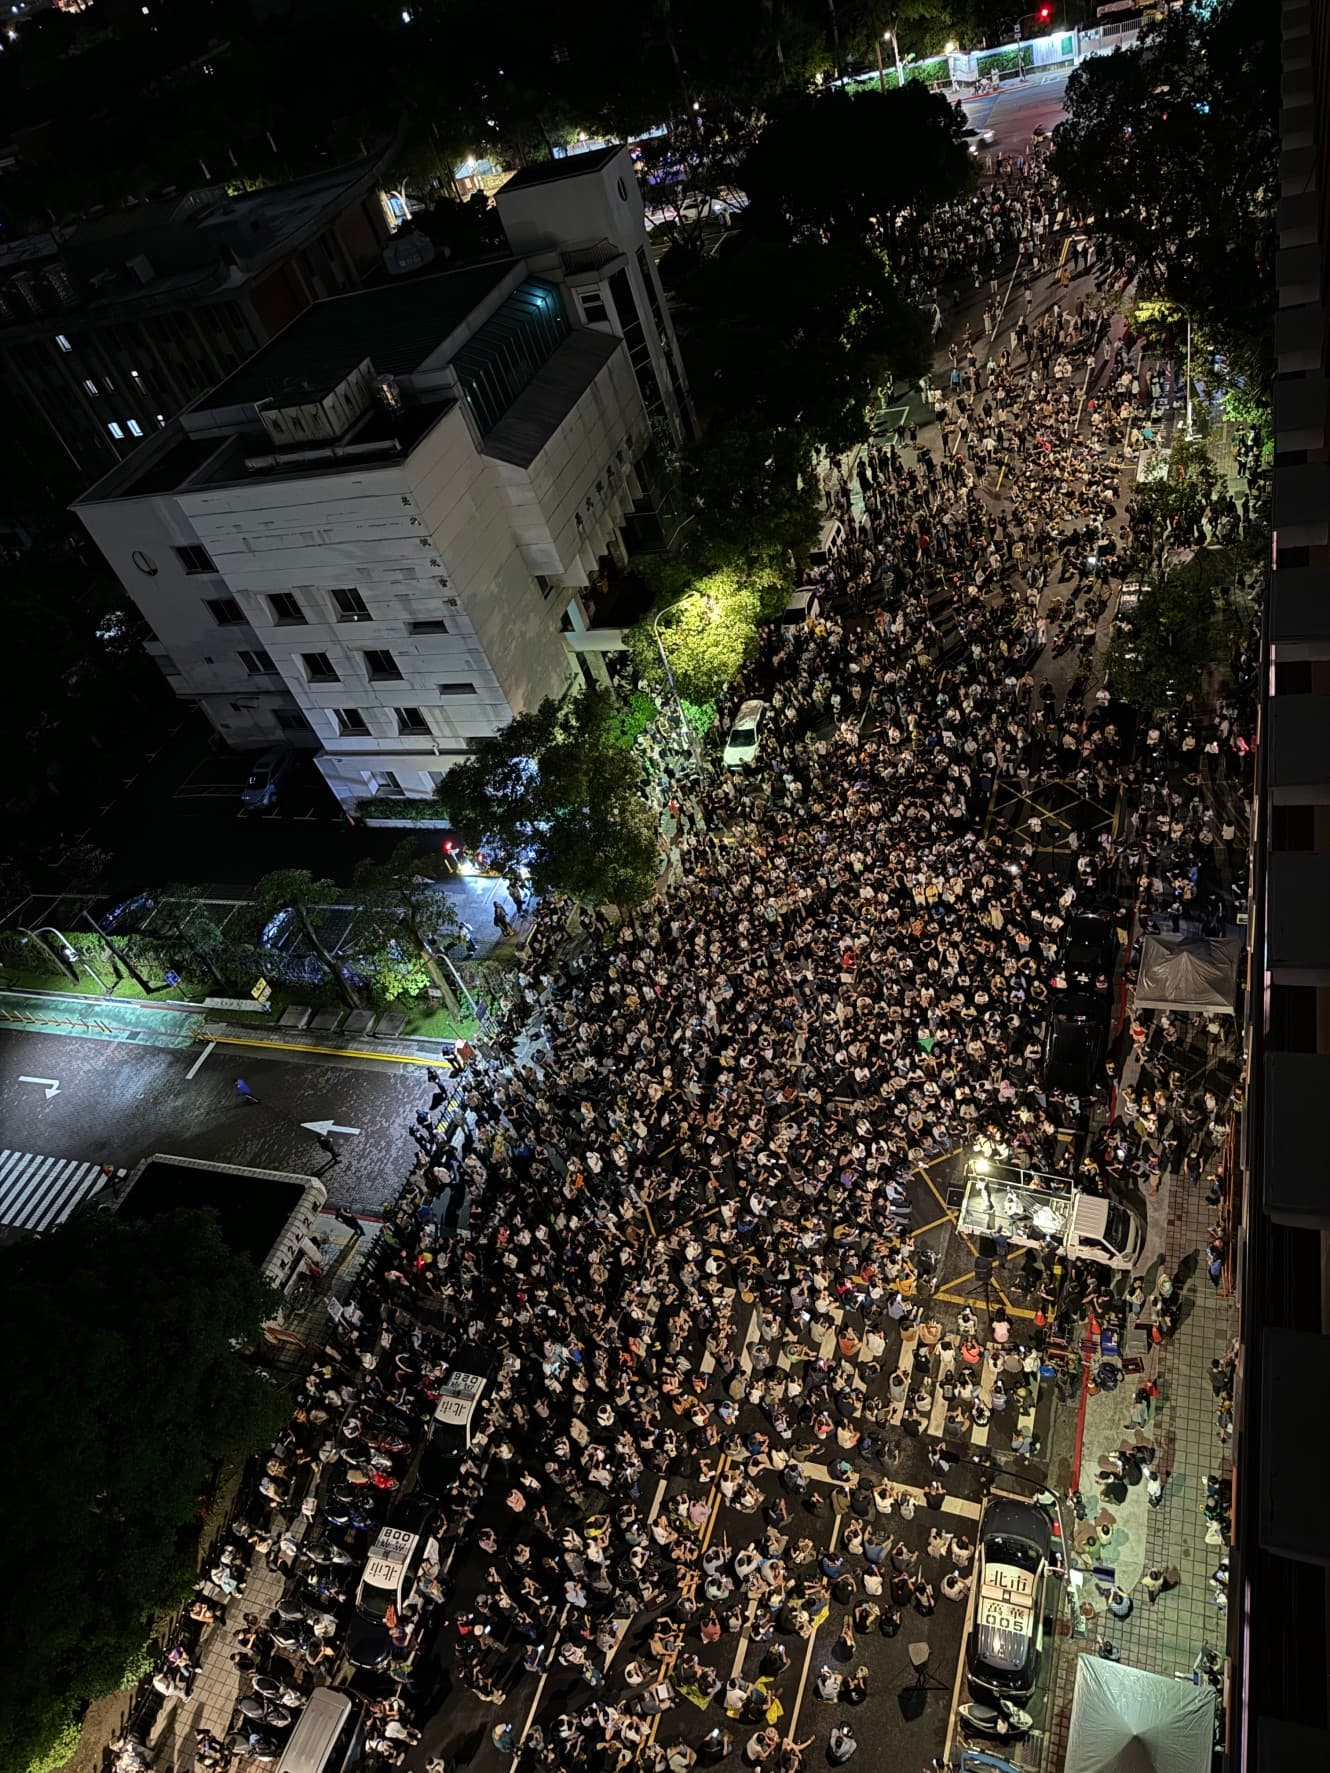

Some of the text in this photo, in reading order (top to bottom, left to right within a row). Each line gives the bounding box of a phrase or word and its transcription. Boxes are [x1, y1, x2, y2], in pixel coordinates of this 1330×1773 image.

[453, 1373, 478, 1385] 026
[439, 1400, 467, 1417] 北市
[384, 1528, 411, 1543] 008
[368, 1562, 398, 1582] 北市
[989, 1570, 1028, 1592] 北市
[985, 1614, 1024, 1632] 005
